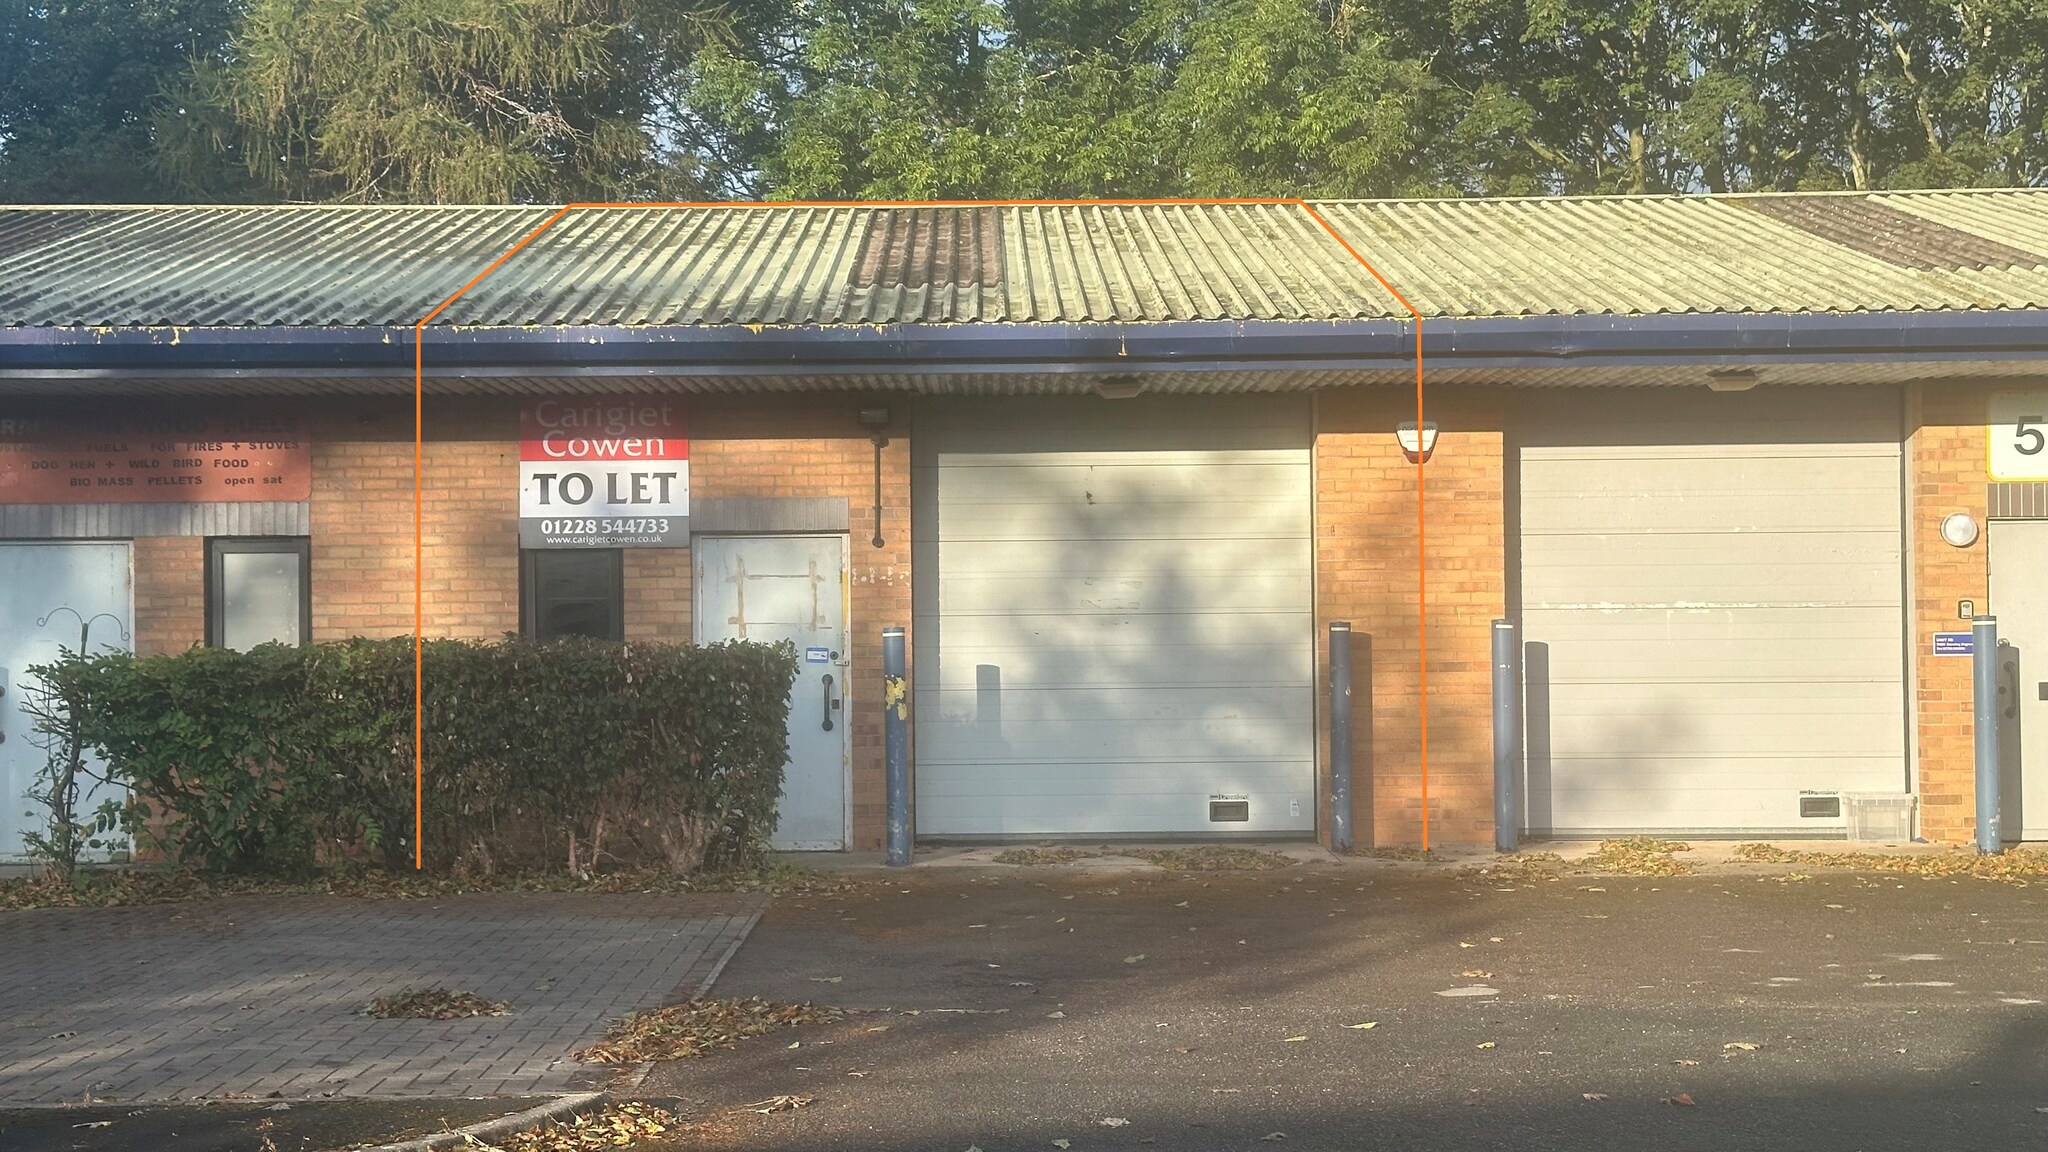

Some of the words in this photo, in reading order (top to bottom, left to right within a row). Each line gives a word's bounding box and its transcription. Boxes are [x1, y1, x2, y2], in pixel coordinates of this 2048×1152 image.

[535, 400, 672, 435] Carigiet
[542, 430, 665, 457] Cowen
[2014, 415, 2045, 455] 5
[87, 443, 129, 452] FUELS
[151, 442, 175, 452] FOR
[187, 441, 223, 452] FIRES
[249, 440, 299, 450] STOVES
[31, 460, 59, 469] DOG
[69, 460, 96, 469] HEN
[129, 459, 160, 468] WILD
[173, 459, 203, 468] BIRD
[214, 459, 249, 468] FOOD
[69, 477, 91, 487] BIO
[98, 477, 134, 486] MASS
[148, 476, 203, 486] PELLETS
[224, 477, 254, 487] open
[262, 475, 283, 485] sat
[532, 472, 594, 505] TO
[605, 472, 677, 504] LET
[541, 519, 597, 535] 01228
[601, 518, 669, 534] 544733
[546, 535, 662, 546] www.carigietcowen.co.uk
